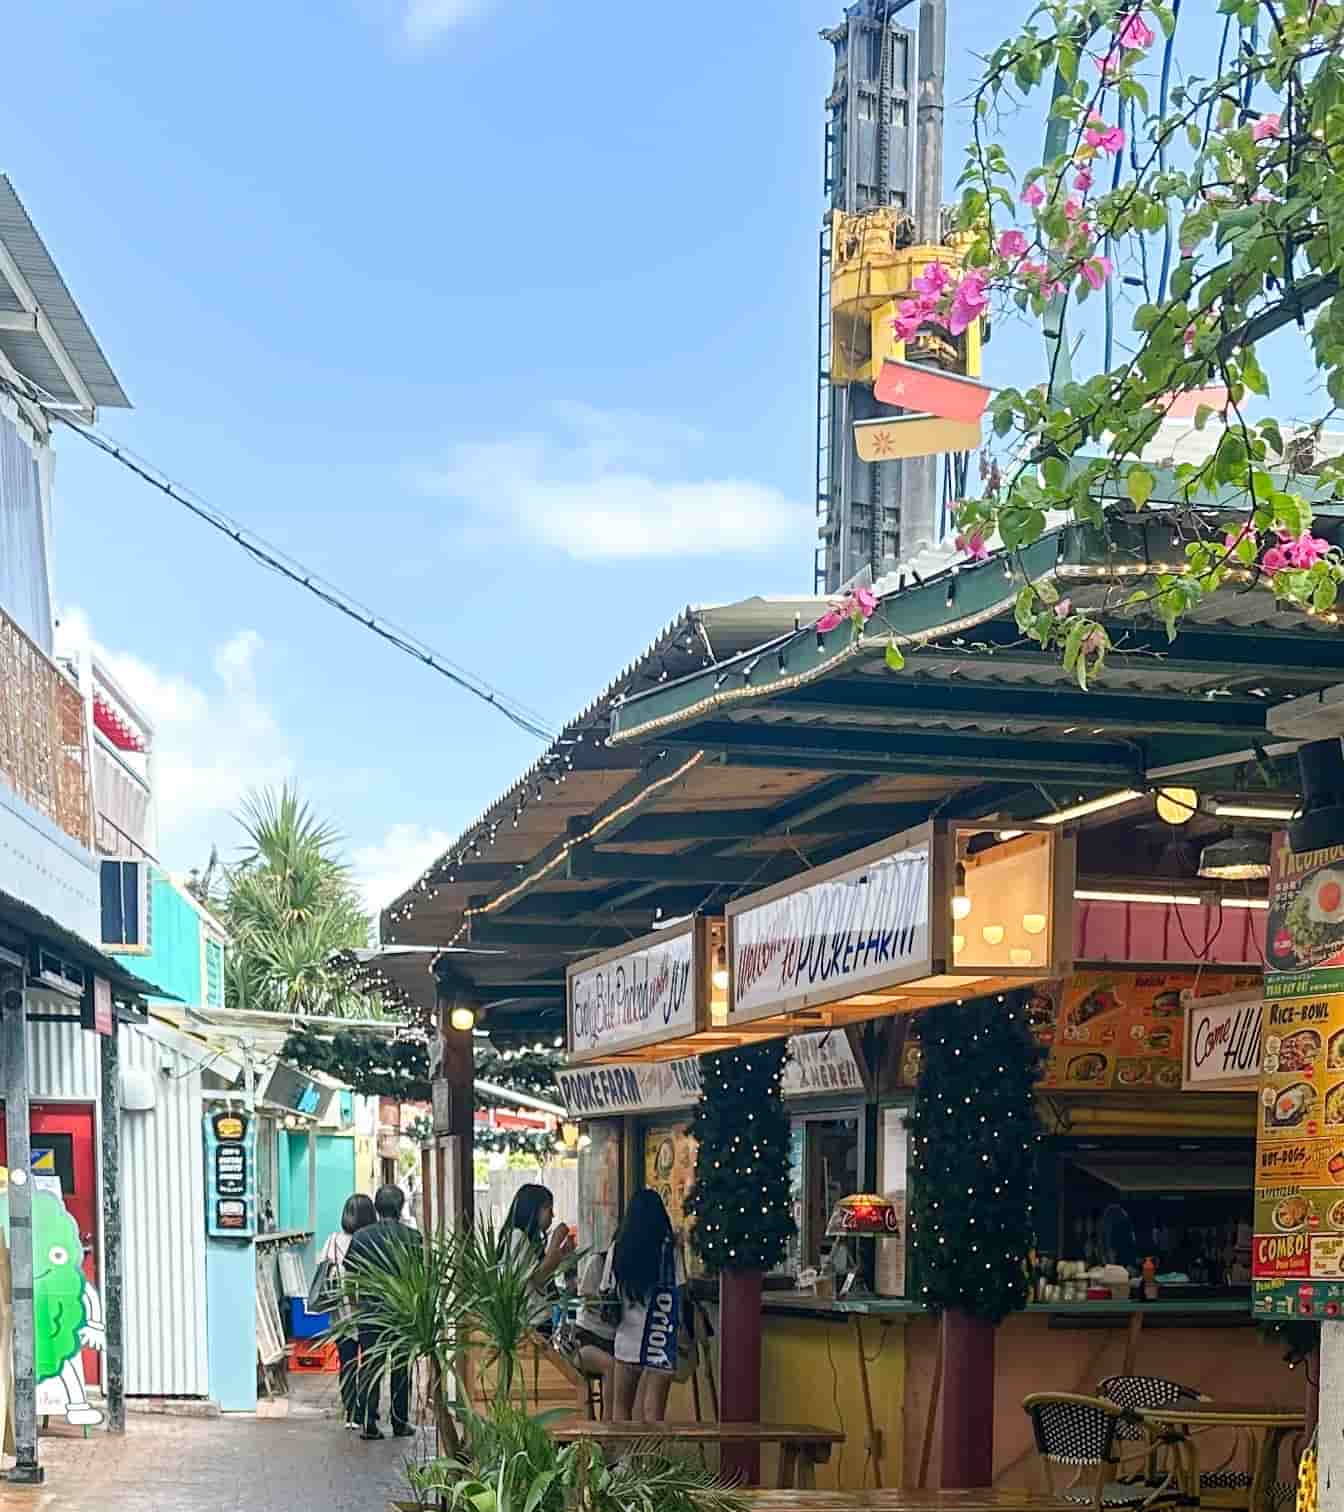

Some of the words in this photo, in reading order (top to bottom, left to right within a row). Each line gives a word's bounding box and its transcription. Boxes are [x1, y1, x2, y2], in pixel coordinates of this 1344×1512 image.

[1194, 1016, 1232, 1068] Come
[1258, 1232, 1310, 1264] COMBO!
[646, 1293, 673, 1363] Orion
